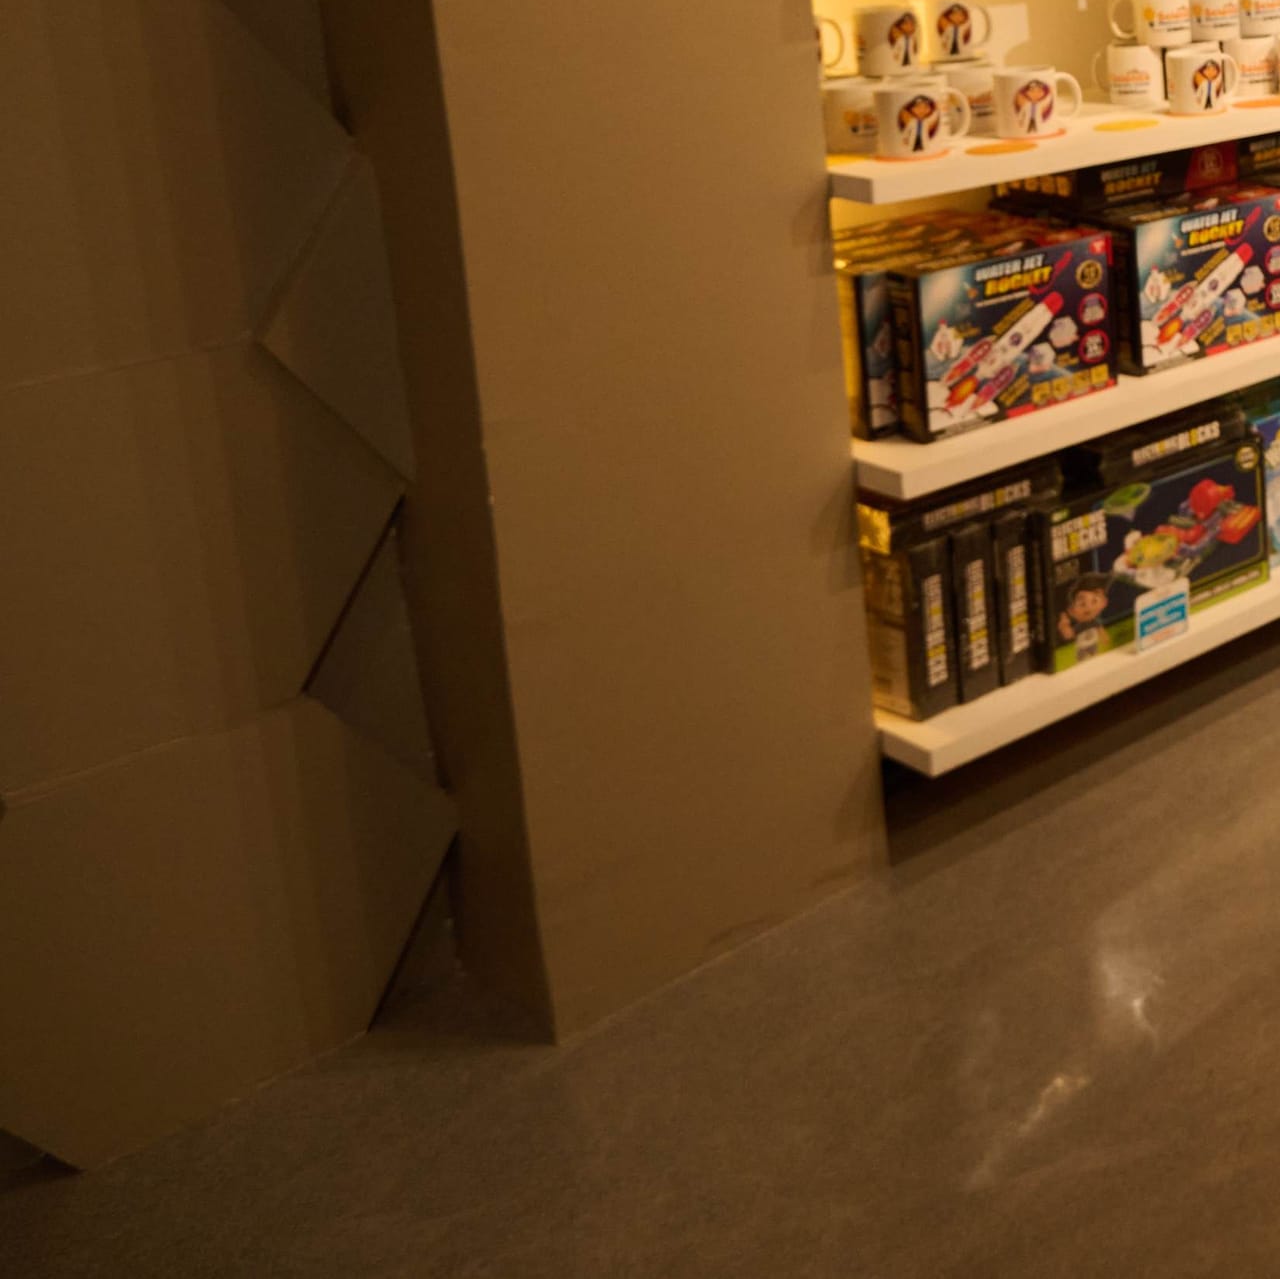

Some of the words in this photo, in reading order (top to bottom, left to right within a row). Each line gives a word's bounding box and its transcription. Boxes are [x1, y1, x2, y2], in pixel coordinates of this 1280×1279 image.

[1181, 213, 1219, 233] WATER
[1188, 220, 1245, 246] ROCKET
[975, 260, 1022, 281] WATER
[1023, 254, 1045, 270] JET
[985, 266, 1053, 296] ROCKET
